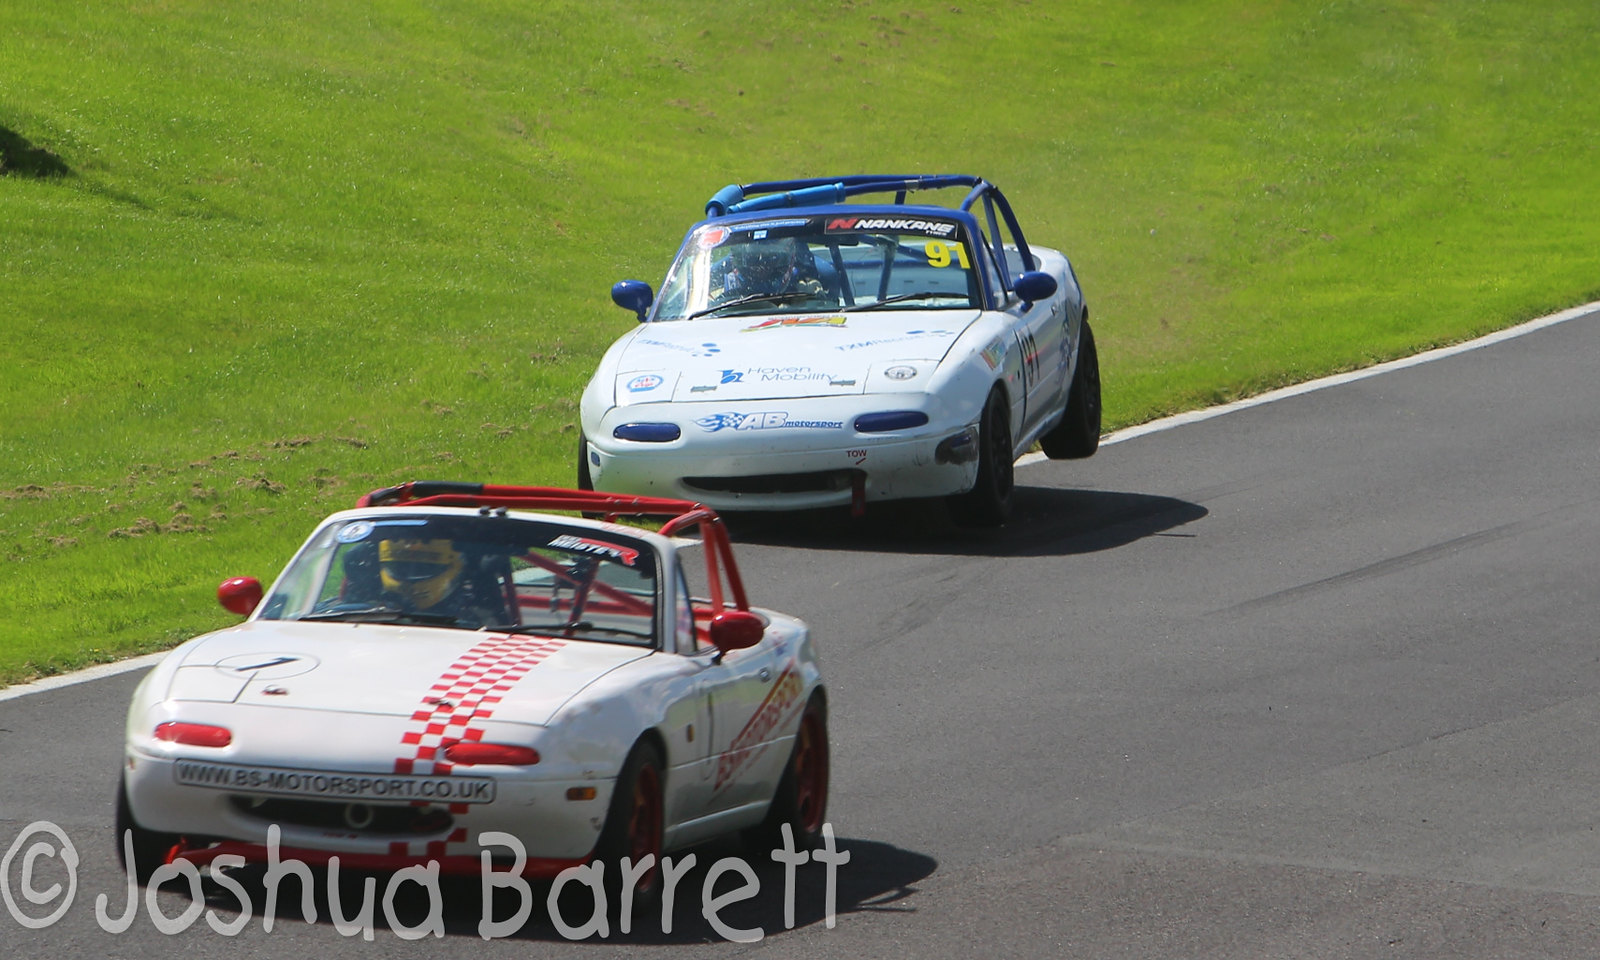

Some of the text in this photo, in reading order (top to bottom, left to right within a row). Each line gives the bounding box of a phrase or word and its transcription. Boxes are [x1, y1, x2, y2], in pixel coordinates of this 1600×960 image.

[854, 219, 955, 233] NANKANG
[925, 240, 971, 269] 91
[747, 366, 812, 375] Haven
[761, 373, 839, 383] Mobility
[736, 411, 843, 431] AB motorsport
[846, 449, 868, 458] TOW
[177, 762, 490, 800] WWW.BS-MOTORSPORT.CO.UK
